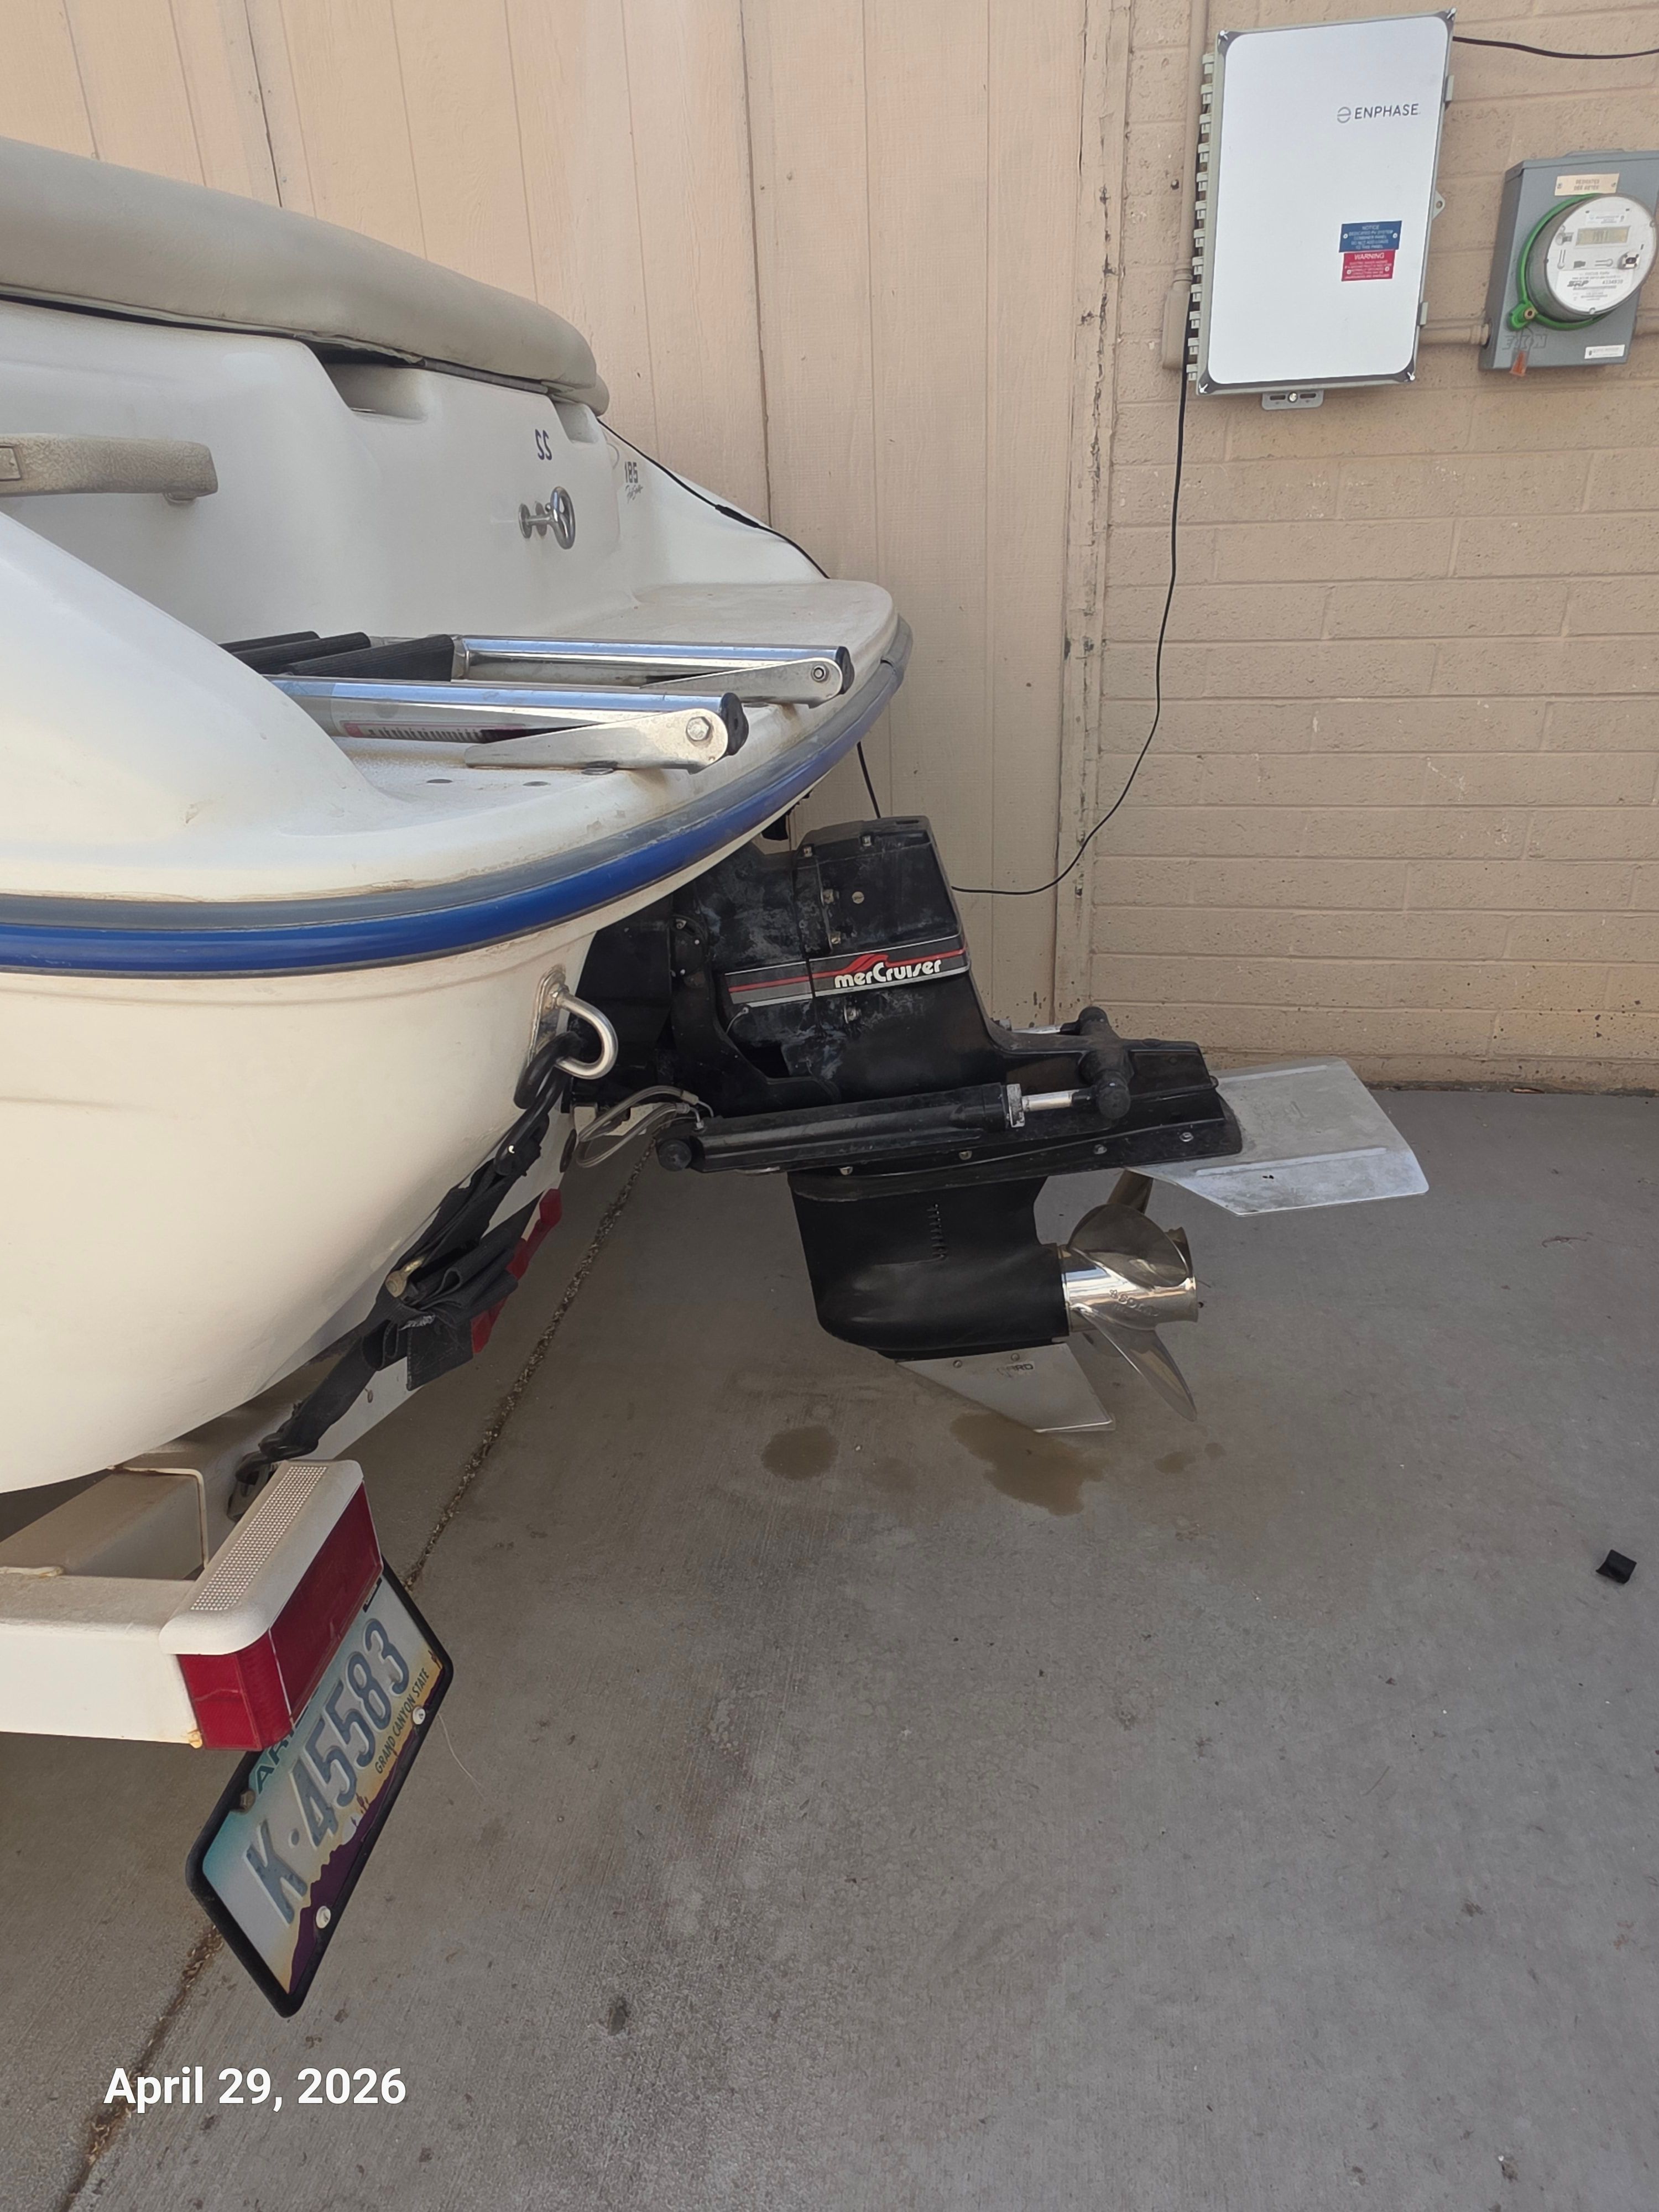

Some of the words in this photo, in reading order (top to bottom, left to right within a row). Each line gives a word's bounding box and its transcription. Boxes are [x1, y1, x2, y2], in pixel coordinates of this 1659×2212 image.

[1355, 103, 1419, 119] ENPHASE
[624, 461, 638, 483] 185
[375, 1736, 395, 1774] GRAND
[393, 1694, 416, 1736] CANYON
[412, 1668, 430, 1698] STATE
